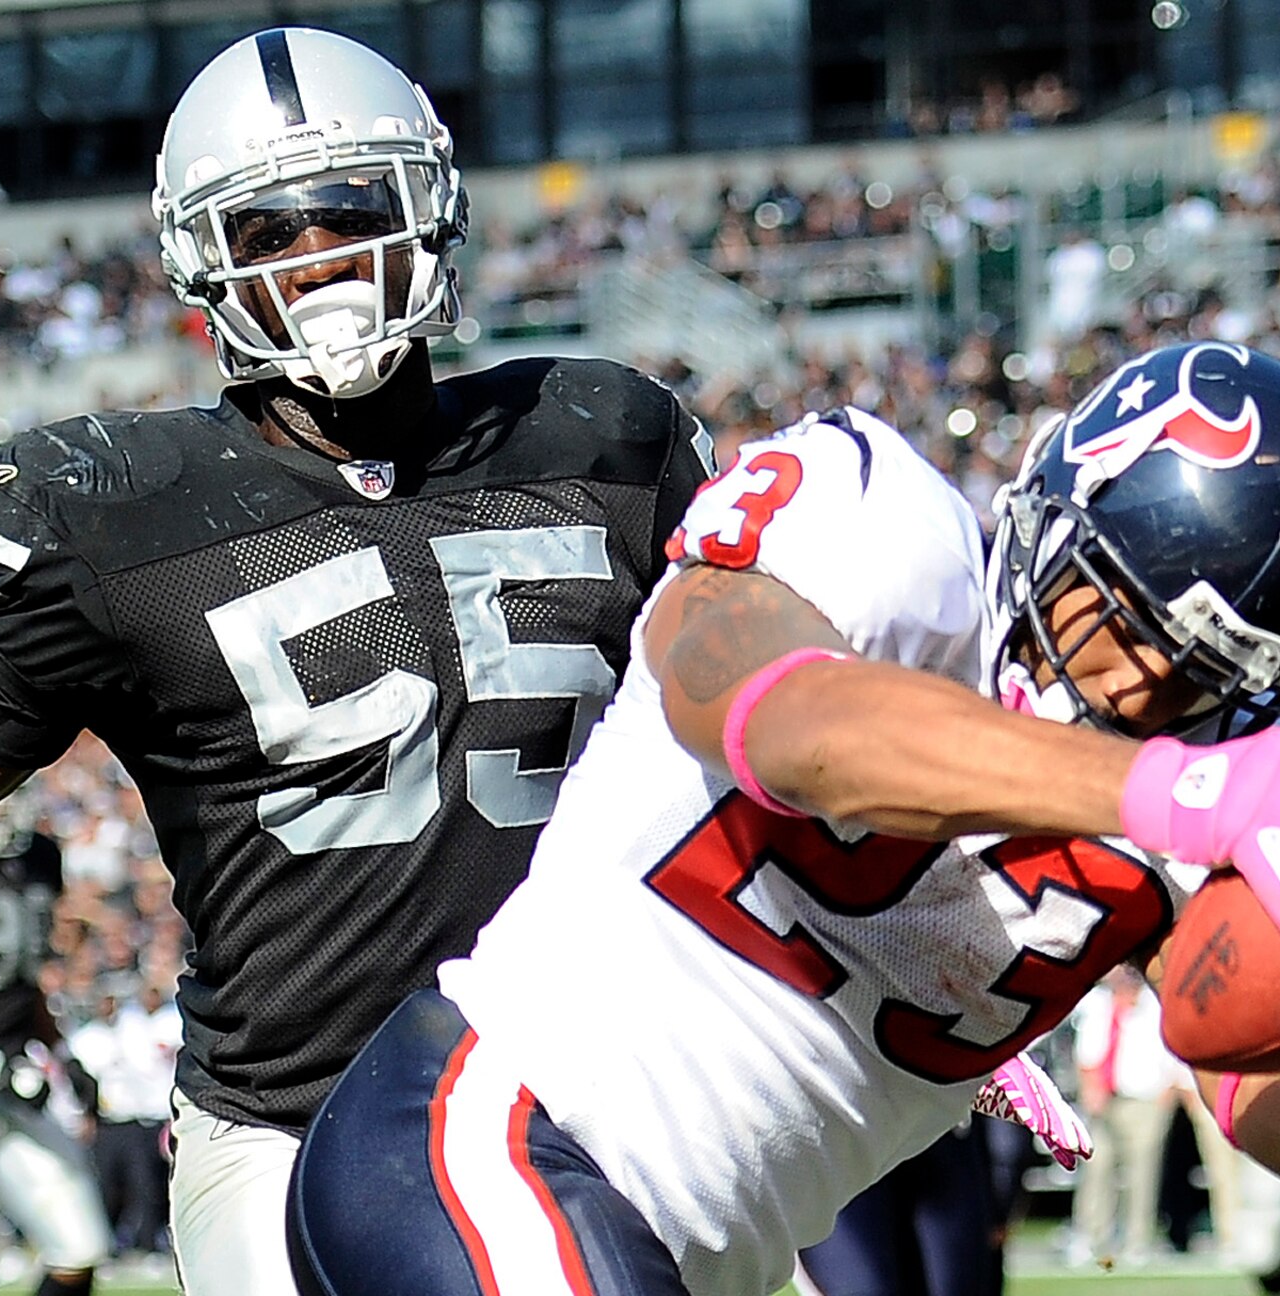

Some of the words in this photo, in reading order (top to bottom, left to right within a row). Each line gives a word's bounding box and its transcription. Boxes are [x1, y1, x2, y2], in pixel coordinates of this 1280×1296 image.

[664, 450, 803, 571] 3
[204, 525, 618, 855] 55
[640, 786, 1175, 1087] 23
